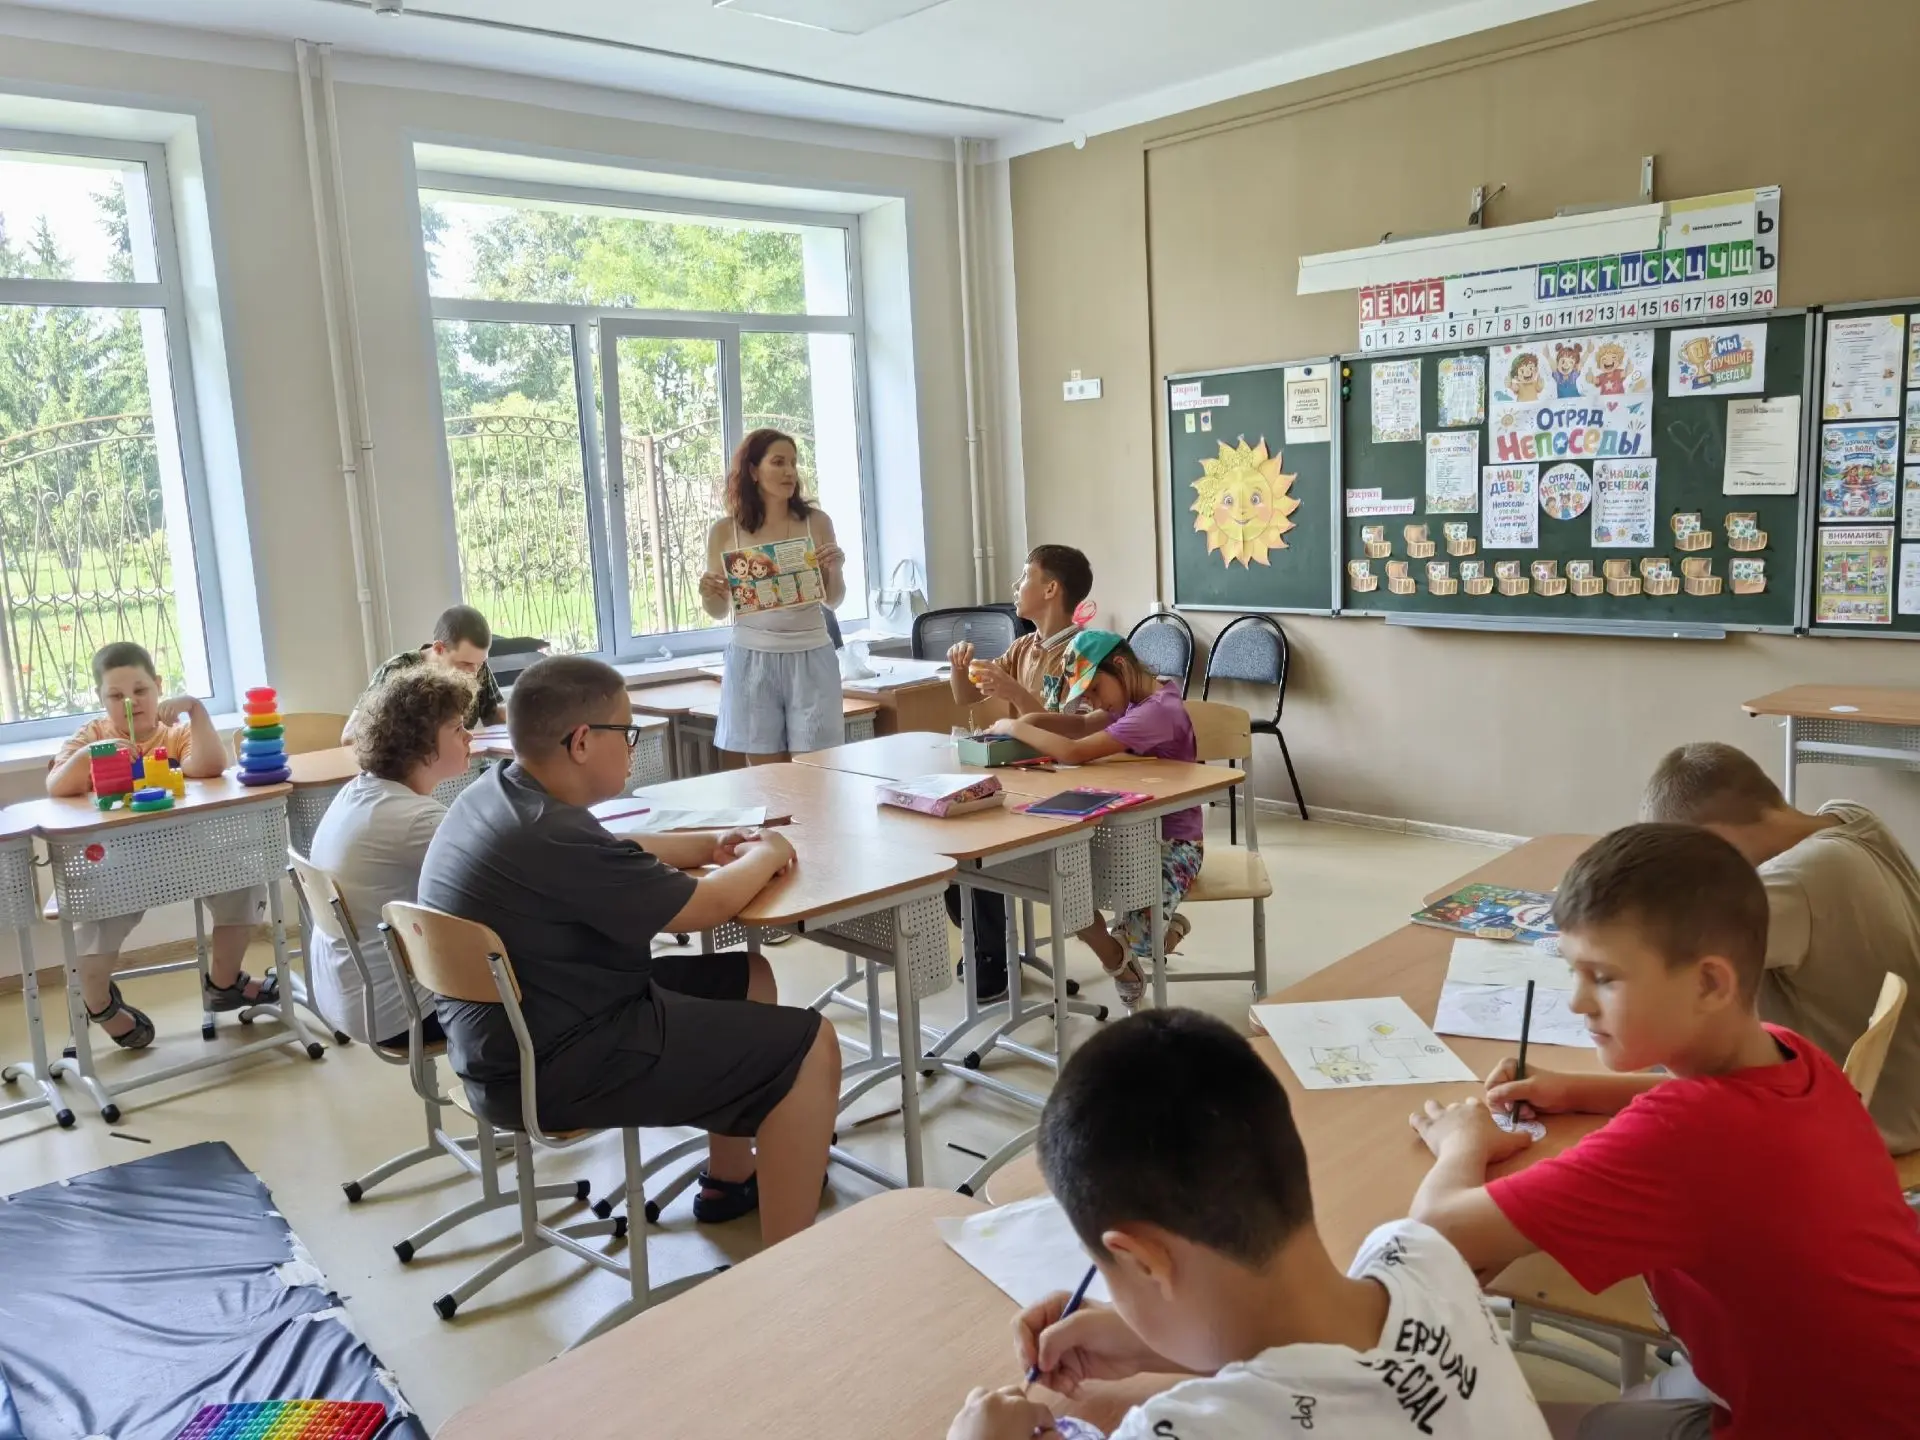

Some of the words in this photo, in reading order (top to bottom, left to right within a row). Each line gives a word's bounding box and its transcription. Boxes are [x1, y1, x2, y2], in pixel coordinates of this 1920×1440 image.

[1365, 334, 1372, 347] 0
[1382, 332, 1388, 345] 1
[1397, 330, 1405, 343] 2
[1414, 329, 1421, 342] 3
[1431, 327, 1439, 340] 4
[1449, 325, 1457, 338] 5
[1467, 323, 1474, 336] 6
[1485, 321, 1493, 334] 7
[1503, 318, 1511, 332] 8
[1522, 316, 1530, 330] 9
[1538, 314, 1553, 328] 10
[1558, 311, 1572, 325] 11
[1576, 309, 1593, 323] 12
[1598, 306, 1614, 321] 13
[1618, 303, 1636, 318] 14
[1640, 301, 1658, 316] 15
[1662, 298, 1679, 314] 16
[1684, 296, 1702, 312] 17
[1707, 294, 1725, 309] 18
[1730, 291, 1748, 307] 19
[1754, 288, 1773, 305] 20
[1717, 337, 1738, 354] МЫ
[1712, 351, 1752, 371] ЛУЧШИЕ
[1497, 469, 1523, 480] НАШ
[1548, 473, 1575, 484] ОТРЯД
[1609, 469, 1639, 479] НАША
[1347, 490, 1379, 500] Экран
[1490, 481, 1531, 497] ДЕВИЗ
[1347, 502, 1413, 514] достижений
